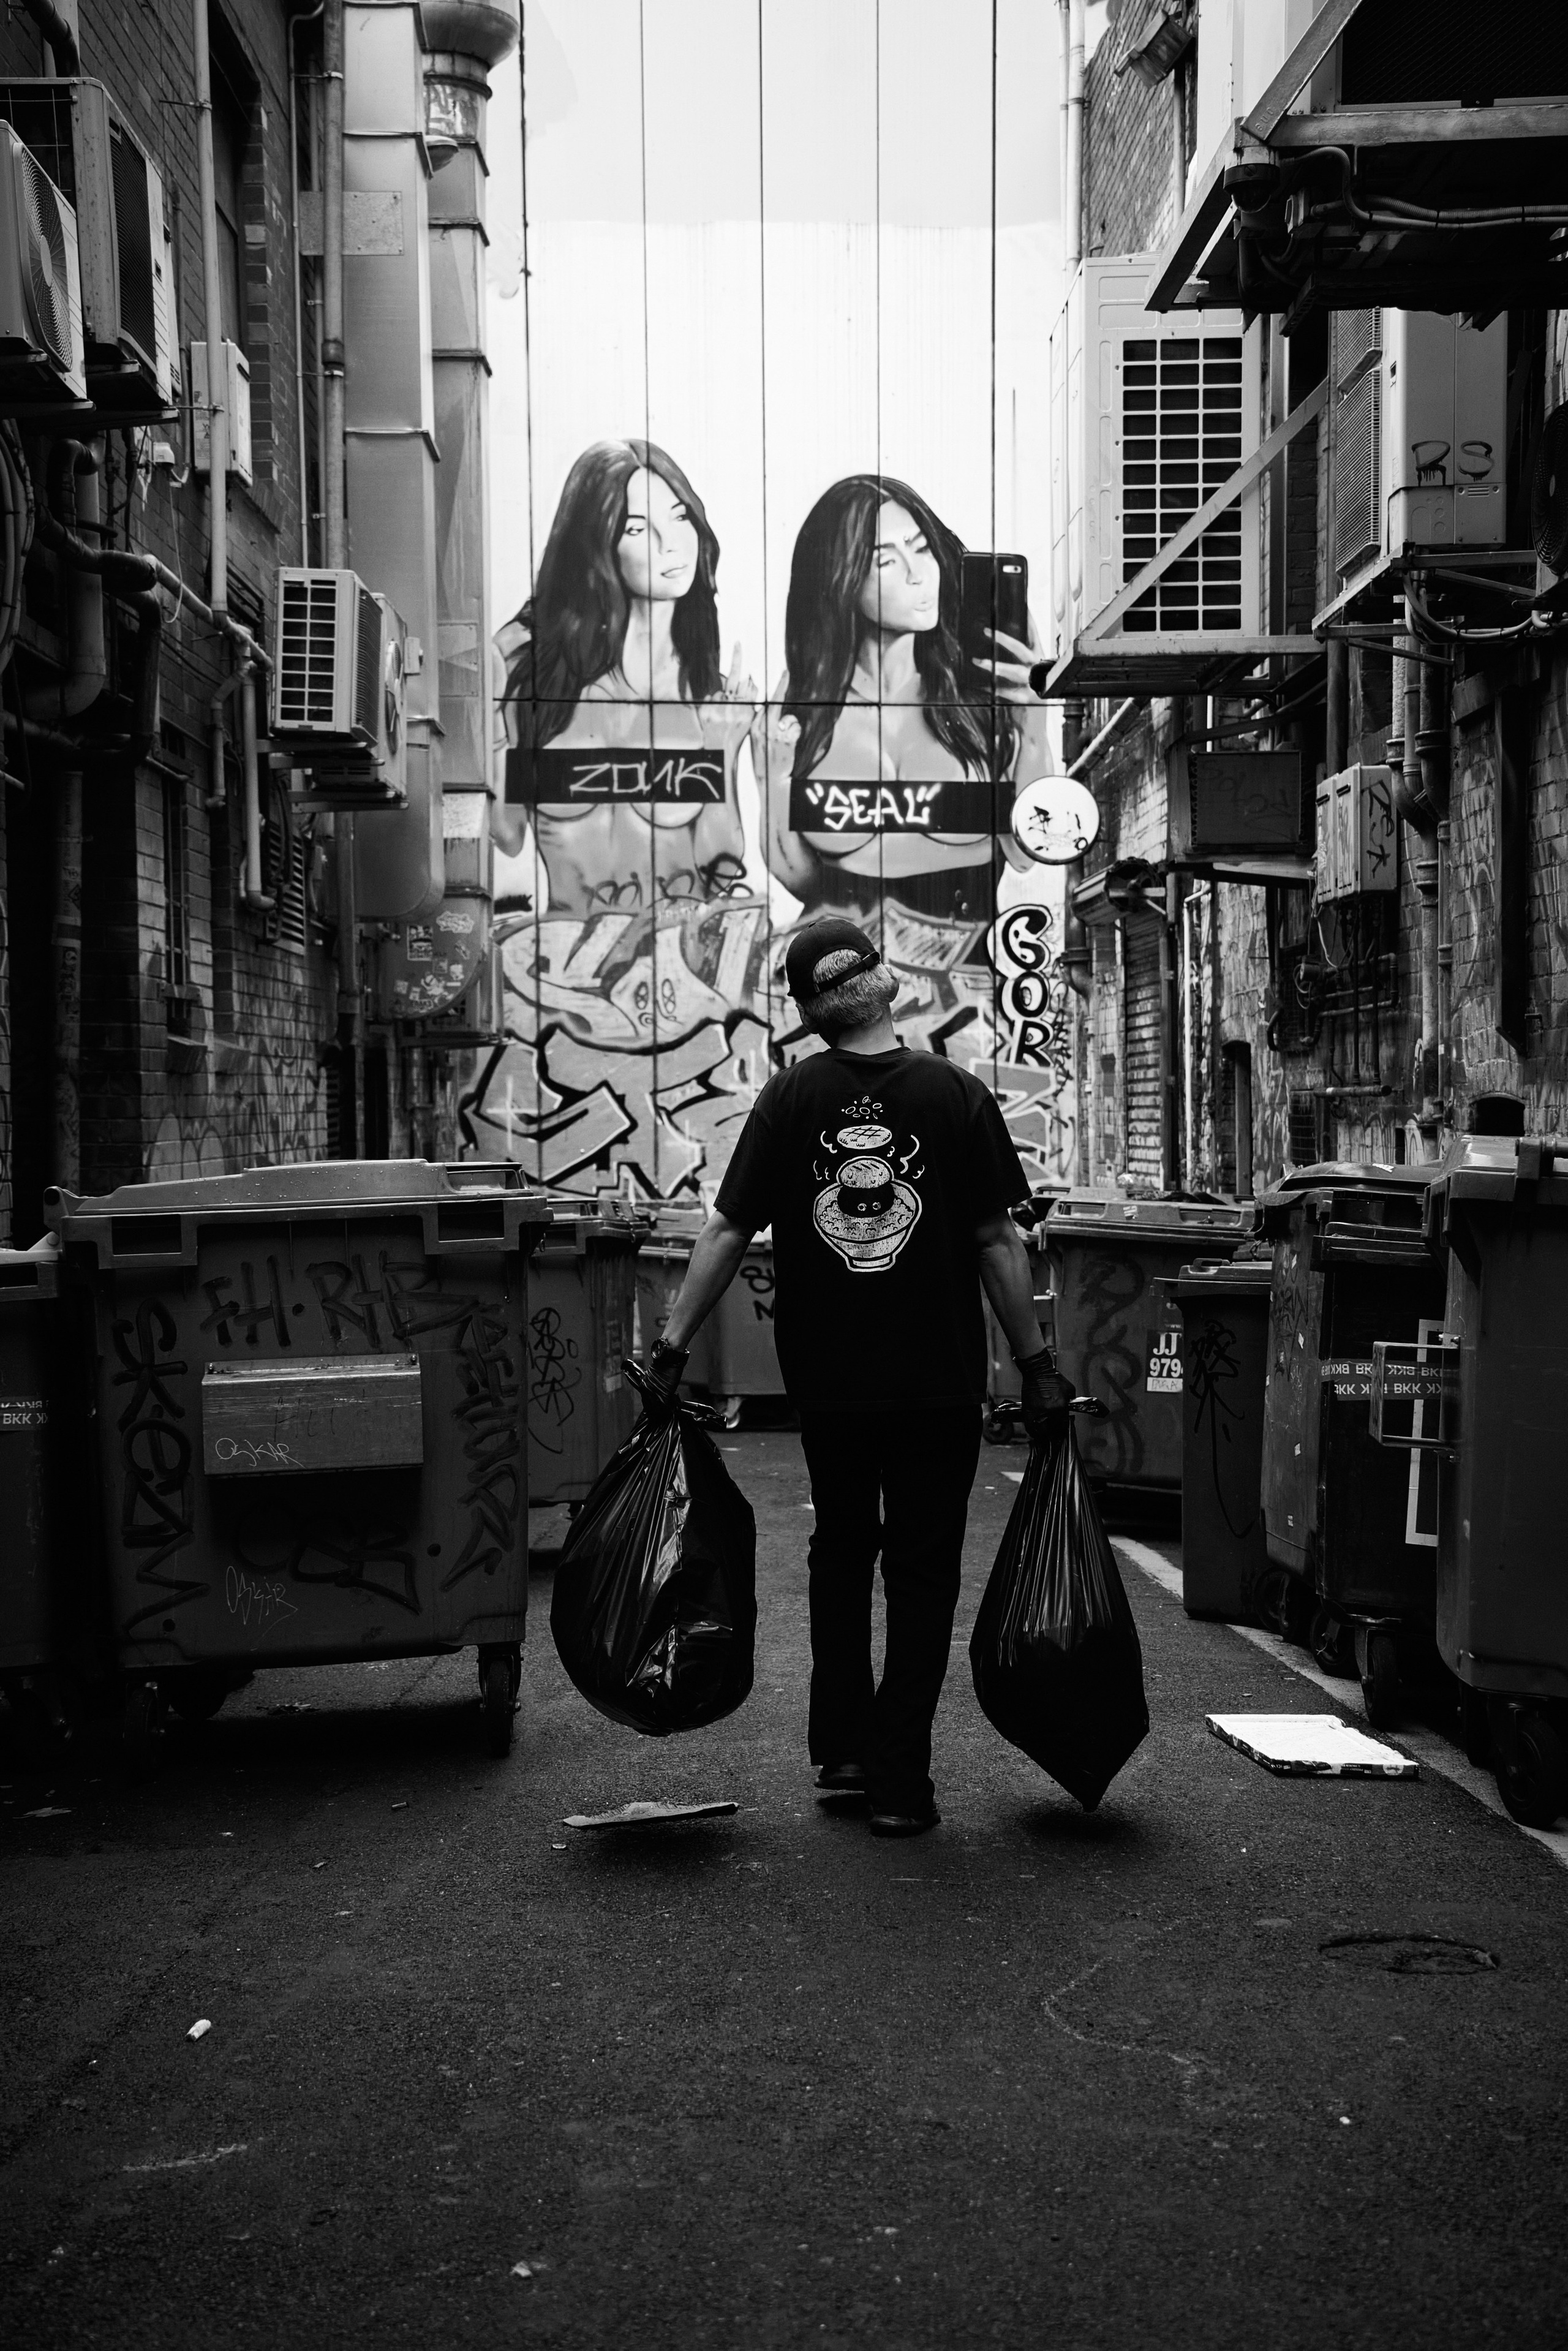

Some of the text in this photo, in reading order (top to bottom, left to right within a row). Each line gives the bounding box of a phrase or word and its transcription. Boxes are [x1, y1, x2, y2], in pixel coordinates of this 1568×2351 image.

[1150, 1357, 1183, 1378] 979
[1355, 1364, 1373, 1374] BK
[1421, 1367, 1442, 1377] BK
[1394, 1383, 1422, 1394] BKK
[2, 1413, 32, 1424] BKK
